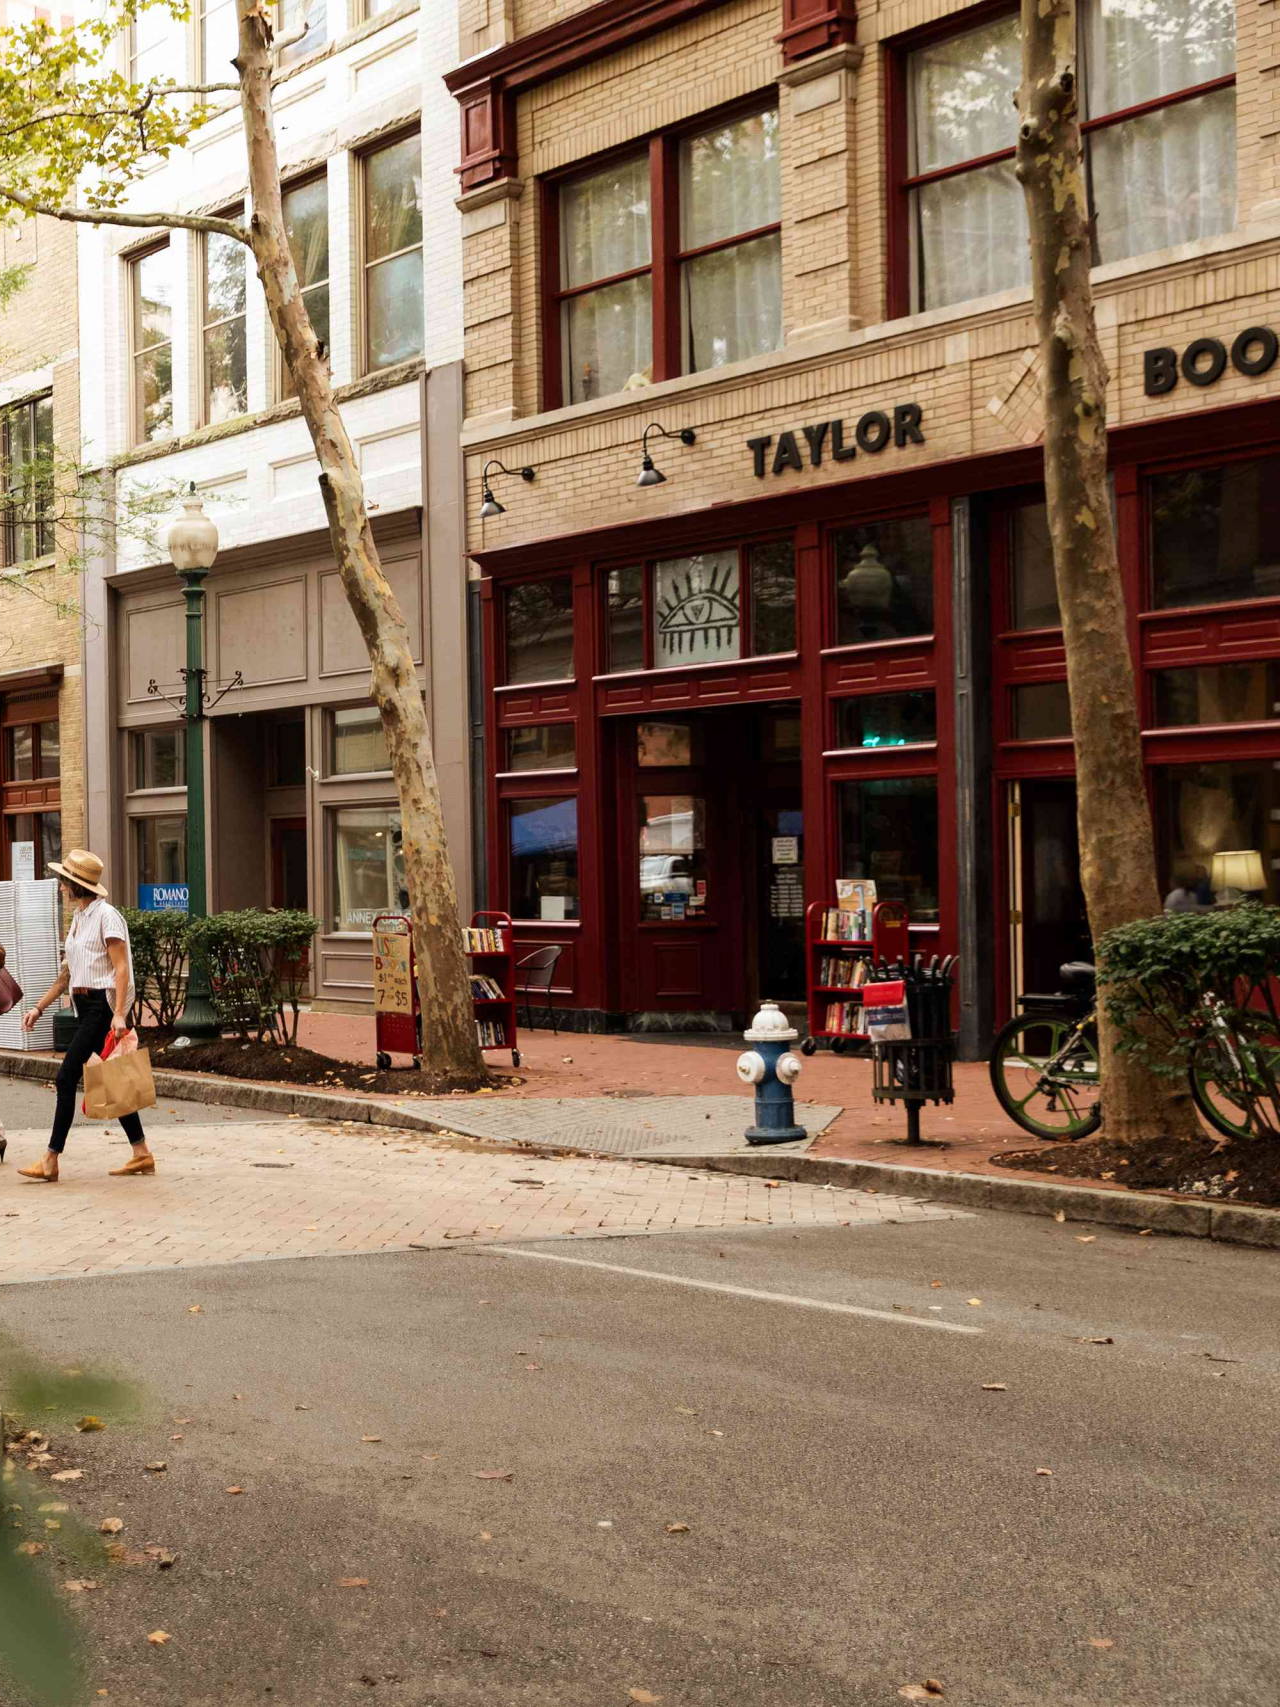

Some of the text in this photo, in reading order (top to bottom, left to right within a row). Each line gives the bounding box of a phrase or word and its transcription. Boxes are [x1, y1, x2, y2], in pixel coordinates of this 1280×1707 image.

[746, 326, 1280, 477] TAYLOR BOO
[153, 887, 189, 901] ROMANO
[346, 911, 377, 924] ANNEX
[395, 990, 408, 1006] $5
